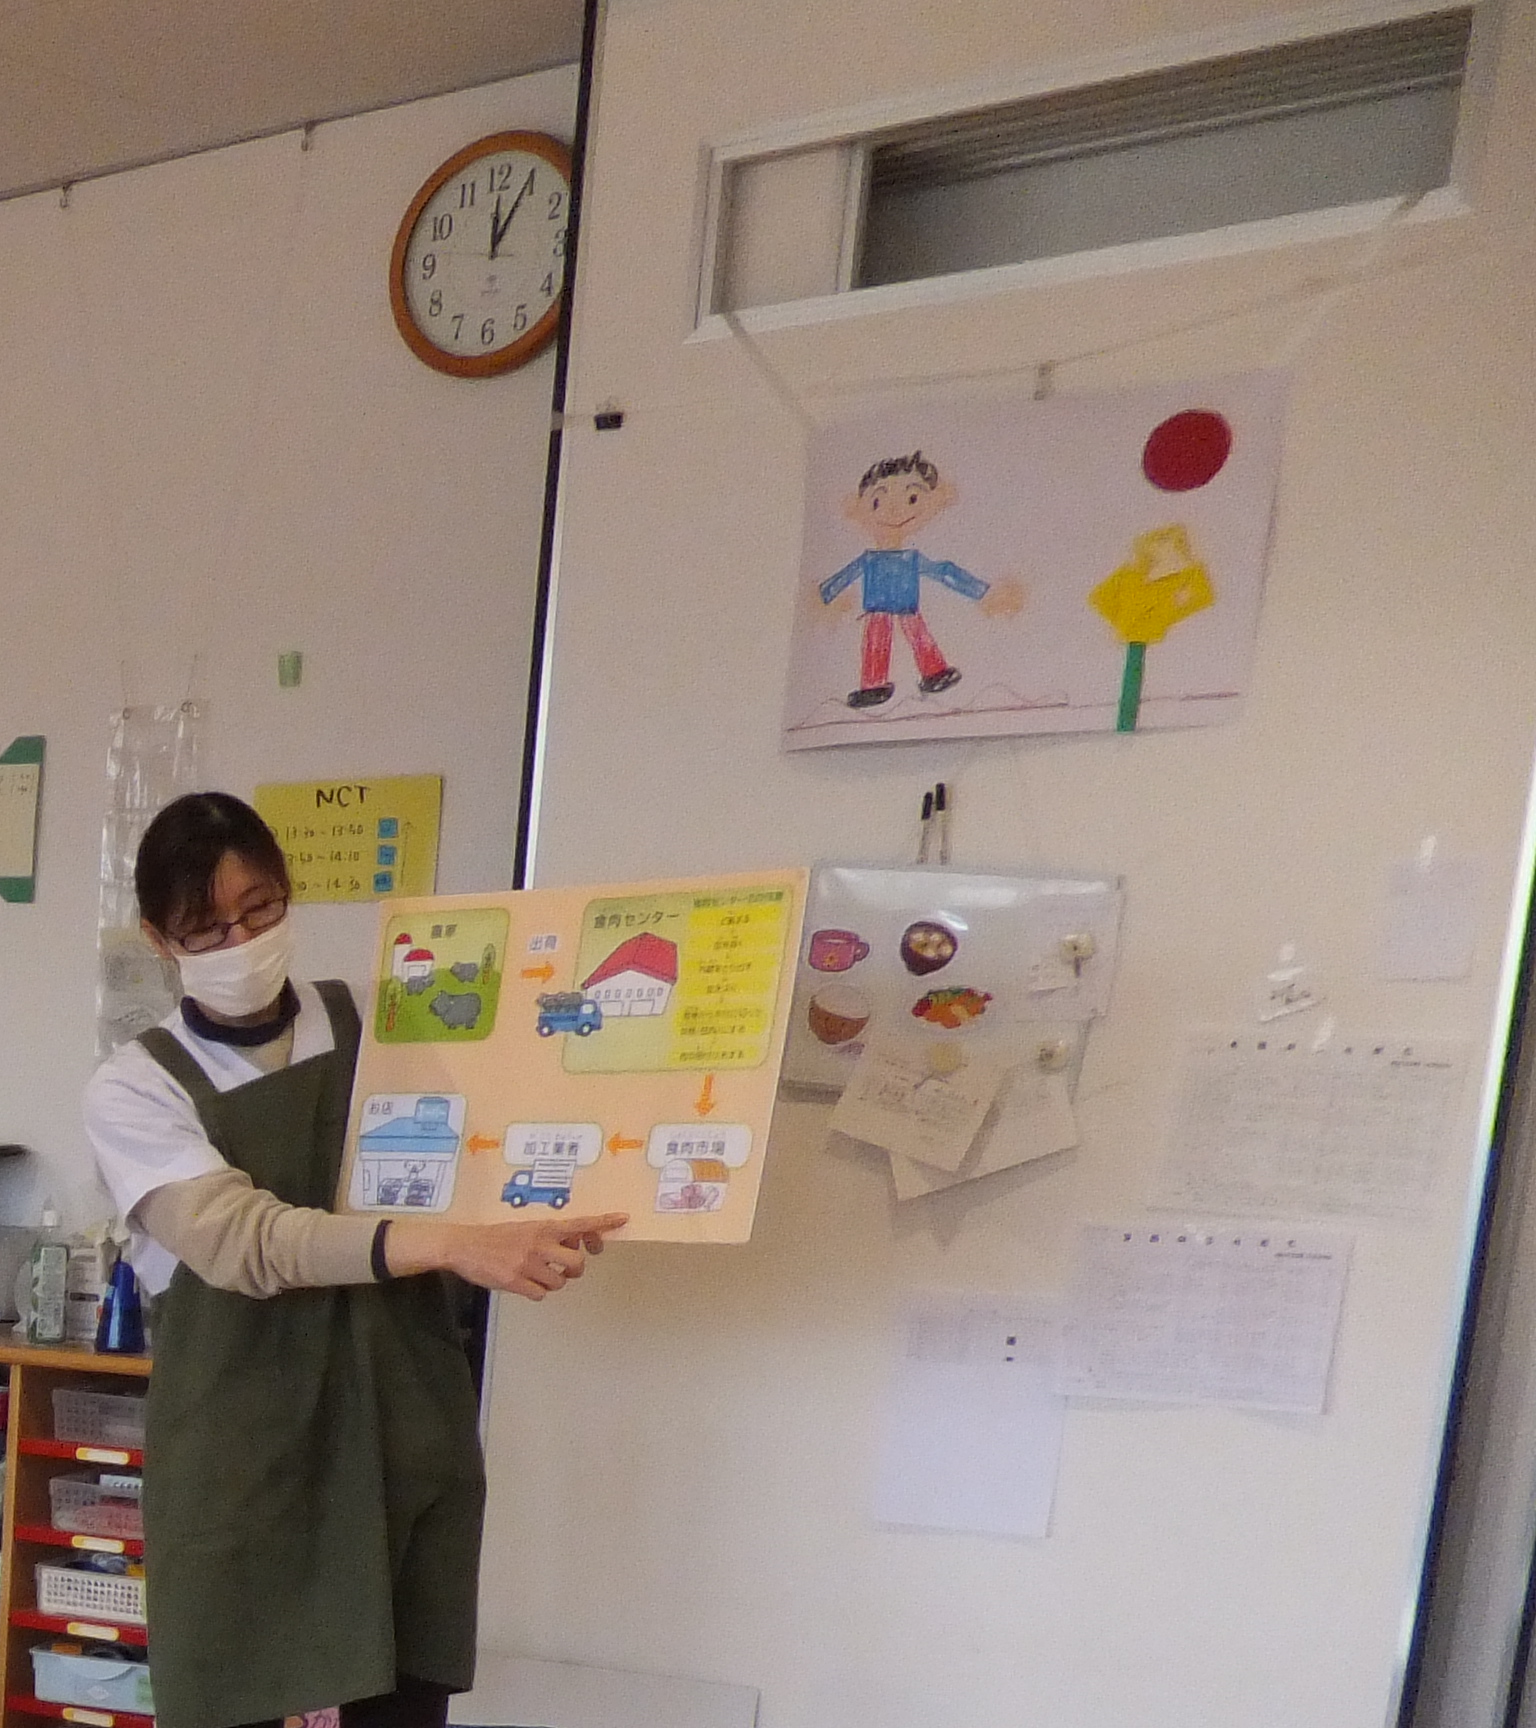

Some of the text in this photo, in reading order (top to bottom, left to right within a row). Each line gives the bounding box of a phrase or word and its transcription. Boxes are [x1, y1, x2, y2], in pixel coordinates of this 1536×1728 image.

[487, 164, 512, 194] 12
[459, 181, 476, 208] 11
[547, 191, 562, 219] 2
[431, 213, 453, 242] 10
[553, 228, 566, 256] 3
[422, 254, 436, 280] 9
[540, 272, 553, 297] 4
[429, 290, 443, 317] 8
[513, 304, 527, 330] 5
[451, 314, 465, 341] 7
[481, 318, 495, 345] 6
[316, 785, 370, 808] NCT
[594, 911, 680, 929] 食肉センター
[665, 1140, 726, 1156] 食肉市場
